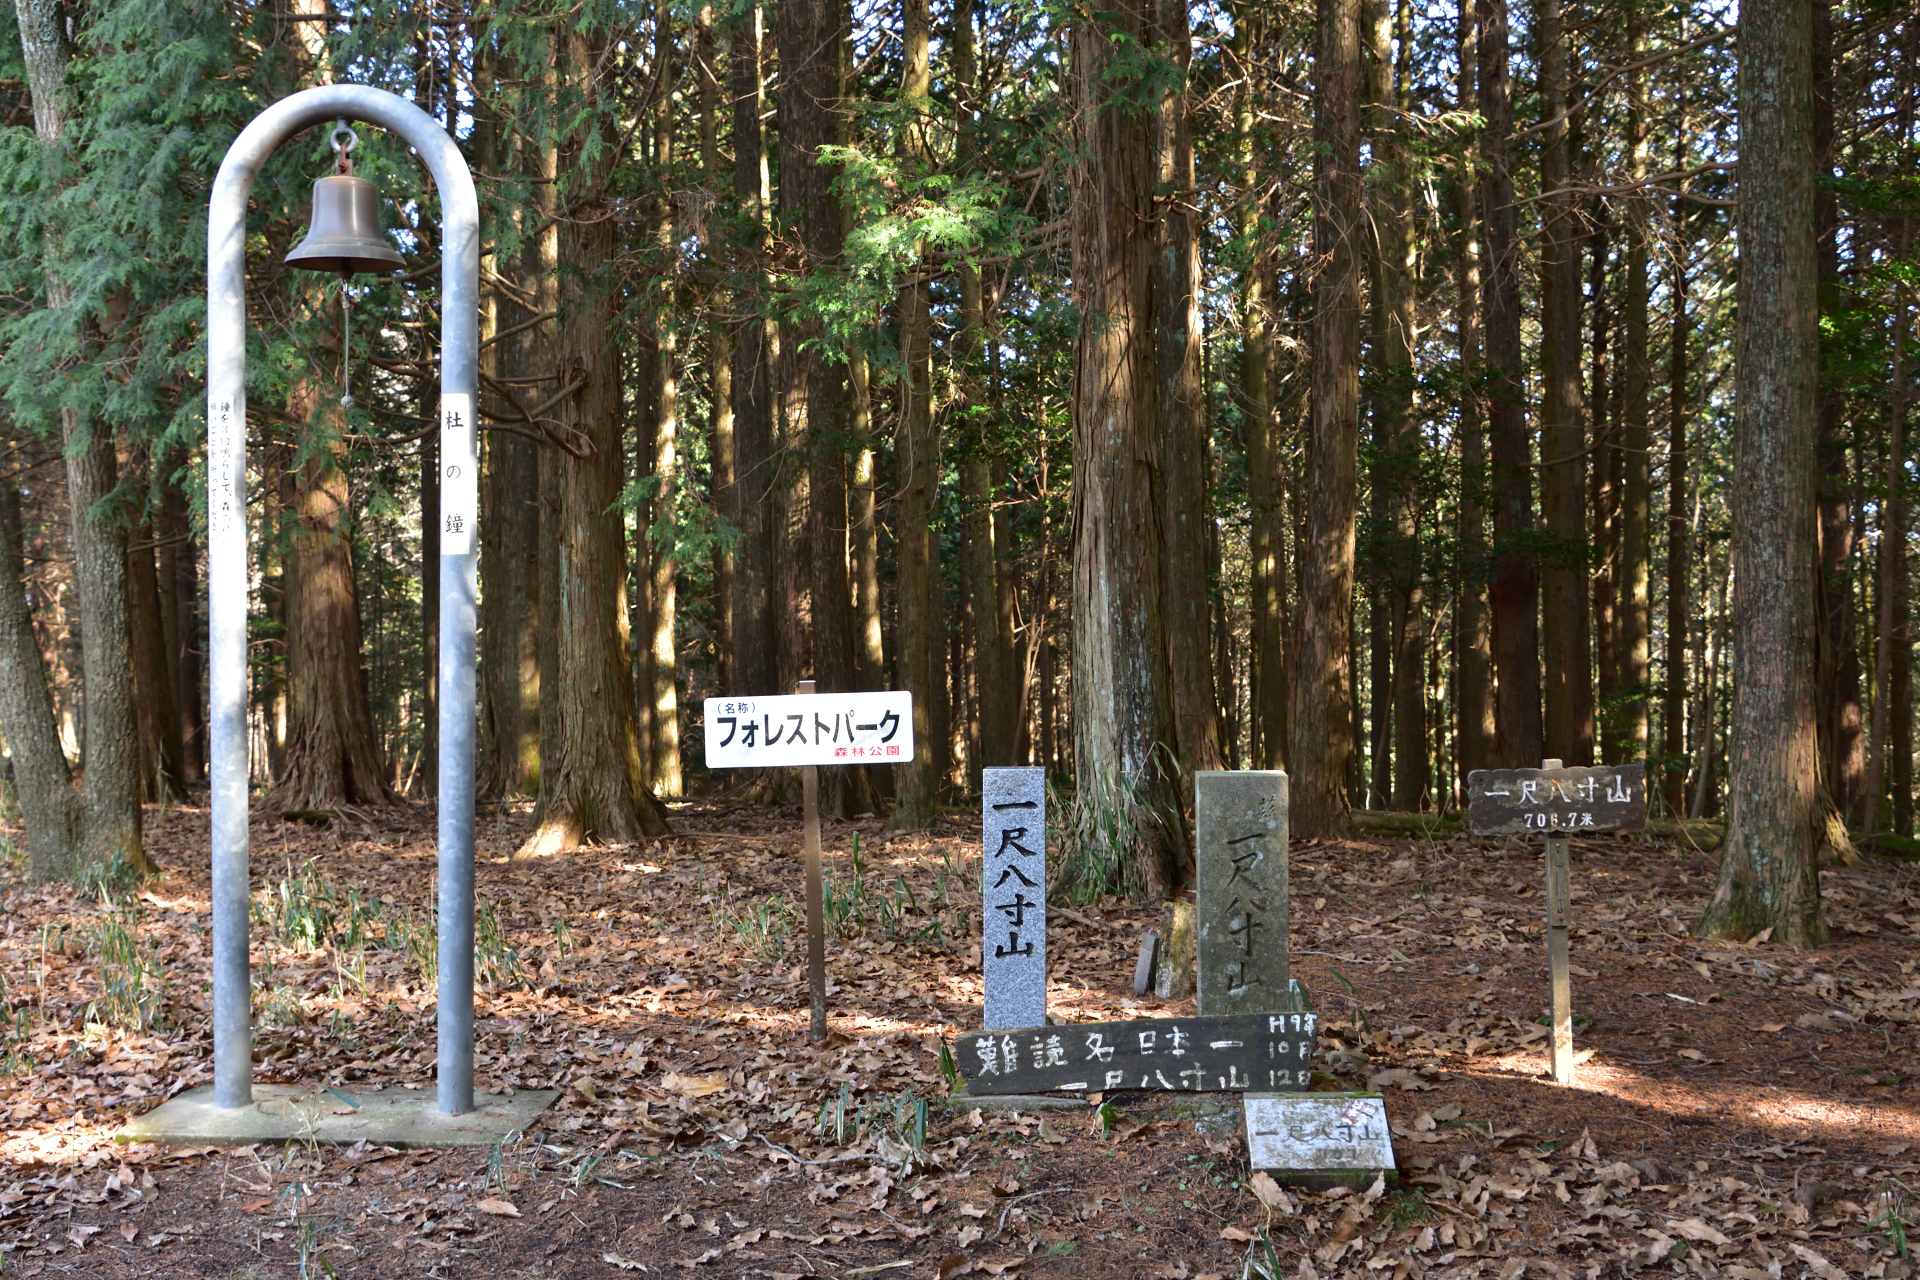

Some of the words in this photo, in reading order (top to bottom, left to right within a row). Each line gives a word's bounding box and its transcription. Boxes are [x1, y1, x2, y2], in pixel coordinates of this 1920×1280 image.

[445, 411, 464, 534] 杜の鐘
[717, 709, 900, 748] フォレストパーク
[834, 745, 900, 758] 森林公園
[1484, 774, 1632, 805] 一尺八寸山
[992, 800, 1040, 959] 一尺八寸山
[1224, 832, 1271, 992] 一尺八寸山
[1055, 1062, 1249, 1090] 一尺八寸山
[1255, 1124, 1380, 1144] 一尺八寸山
